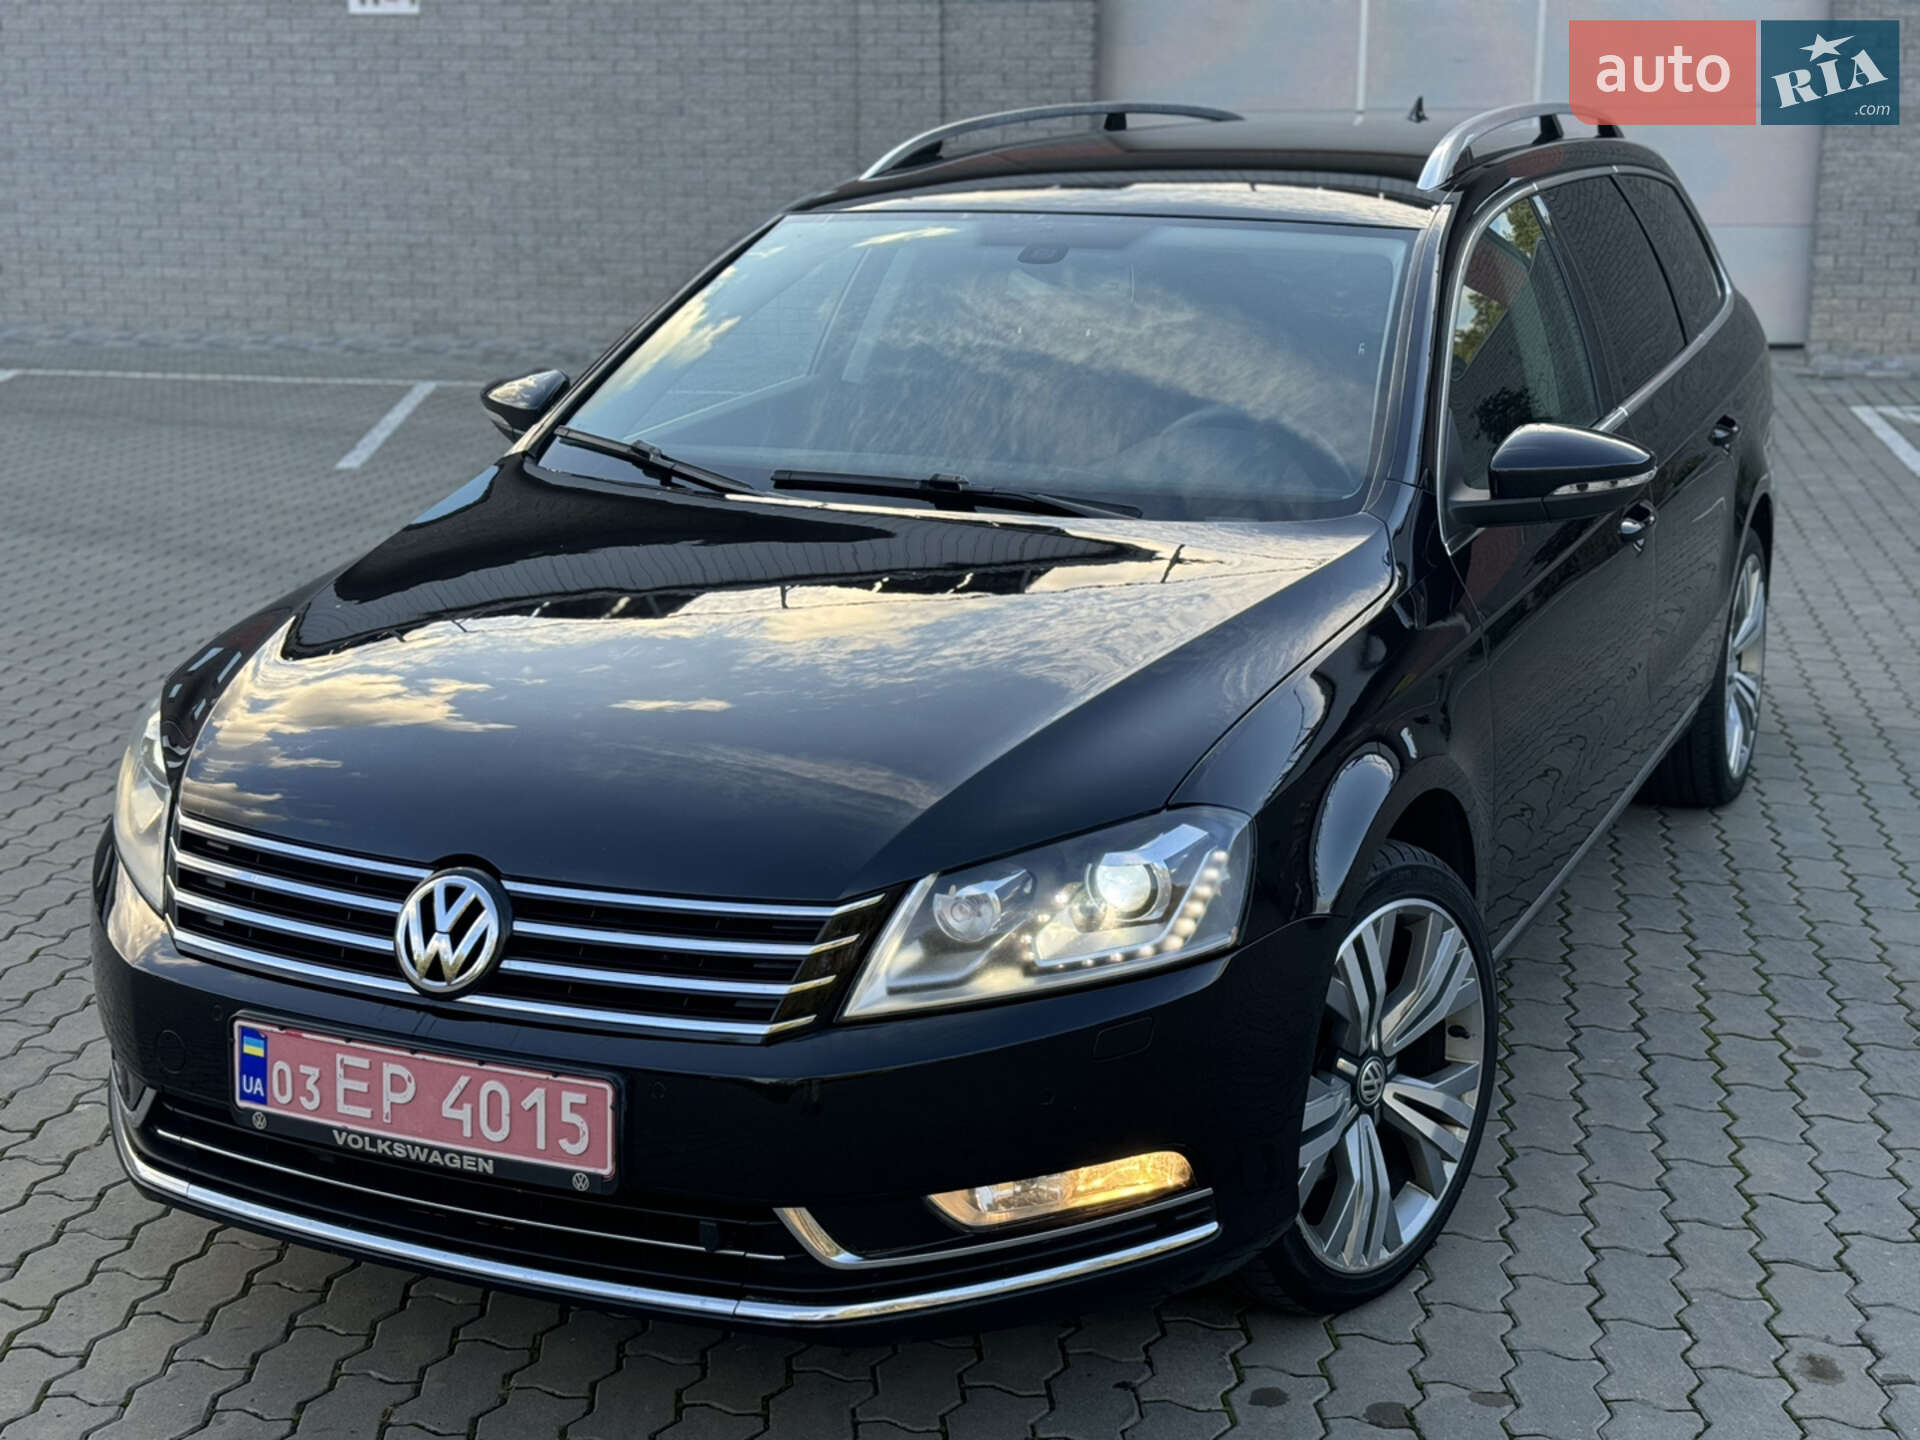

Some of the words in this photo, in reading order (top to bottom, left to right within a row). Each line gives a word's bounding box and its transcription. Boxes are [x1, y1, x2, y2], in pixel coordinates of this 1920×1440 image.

[242, 1074, 264, 1097] UA
[271, 1060, 321, 1111] 03
[335, 1053, 417, 1124] EP
[441, 1075, 589, 1156] 4015
[332, 1129, 495, 1175] VOLKSWAGEN
